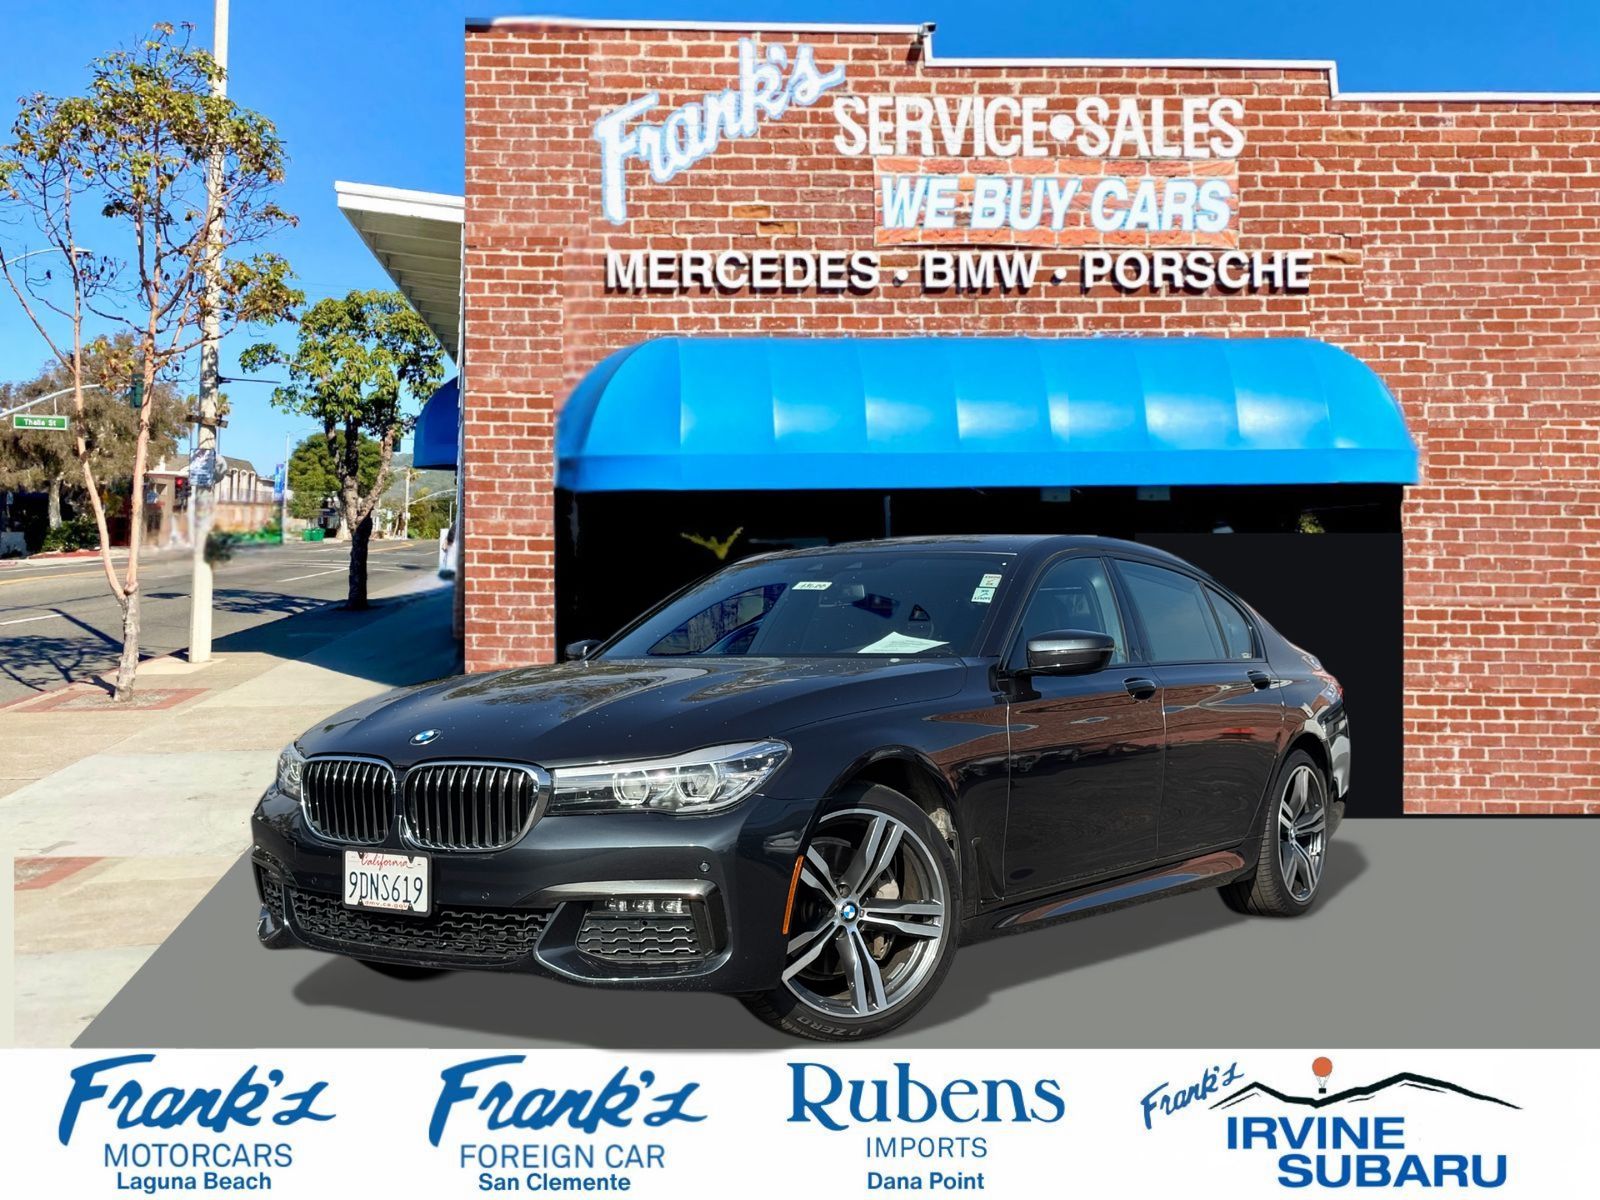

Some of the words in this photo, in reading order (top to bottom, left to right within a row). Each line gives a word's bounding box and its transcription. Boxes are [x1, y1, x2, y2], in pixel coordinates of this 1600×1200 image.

[594, 37, 845, 225] Frank's
[880, 176, 959, 230] WE
[969, 176, 1083, 232] BUY
[1089, 178, 1233, 233] CARS
[606, 250, 880, 290] MERCEDES
[924, 250, 1042, 290] BMW
[1083, 250, 1314, 291] PORSCHE
[48, 418, 57, 426] St
[360, 851, 410, 871] California
[349, 871, 423, 904] 9DNS619
[796, 1016, 847, 1036] ZERO
